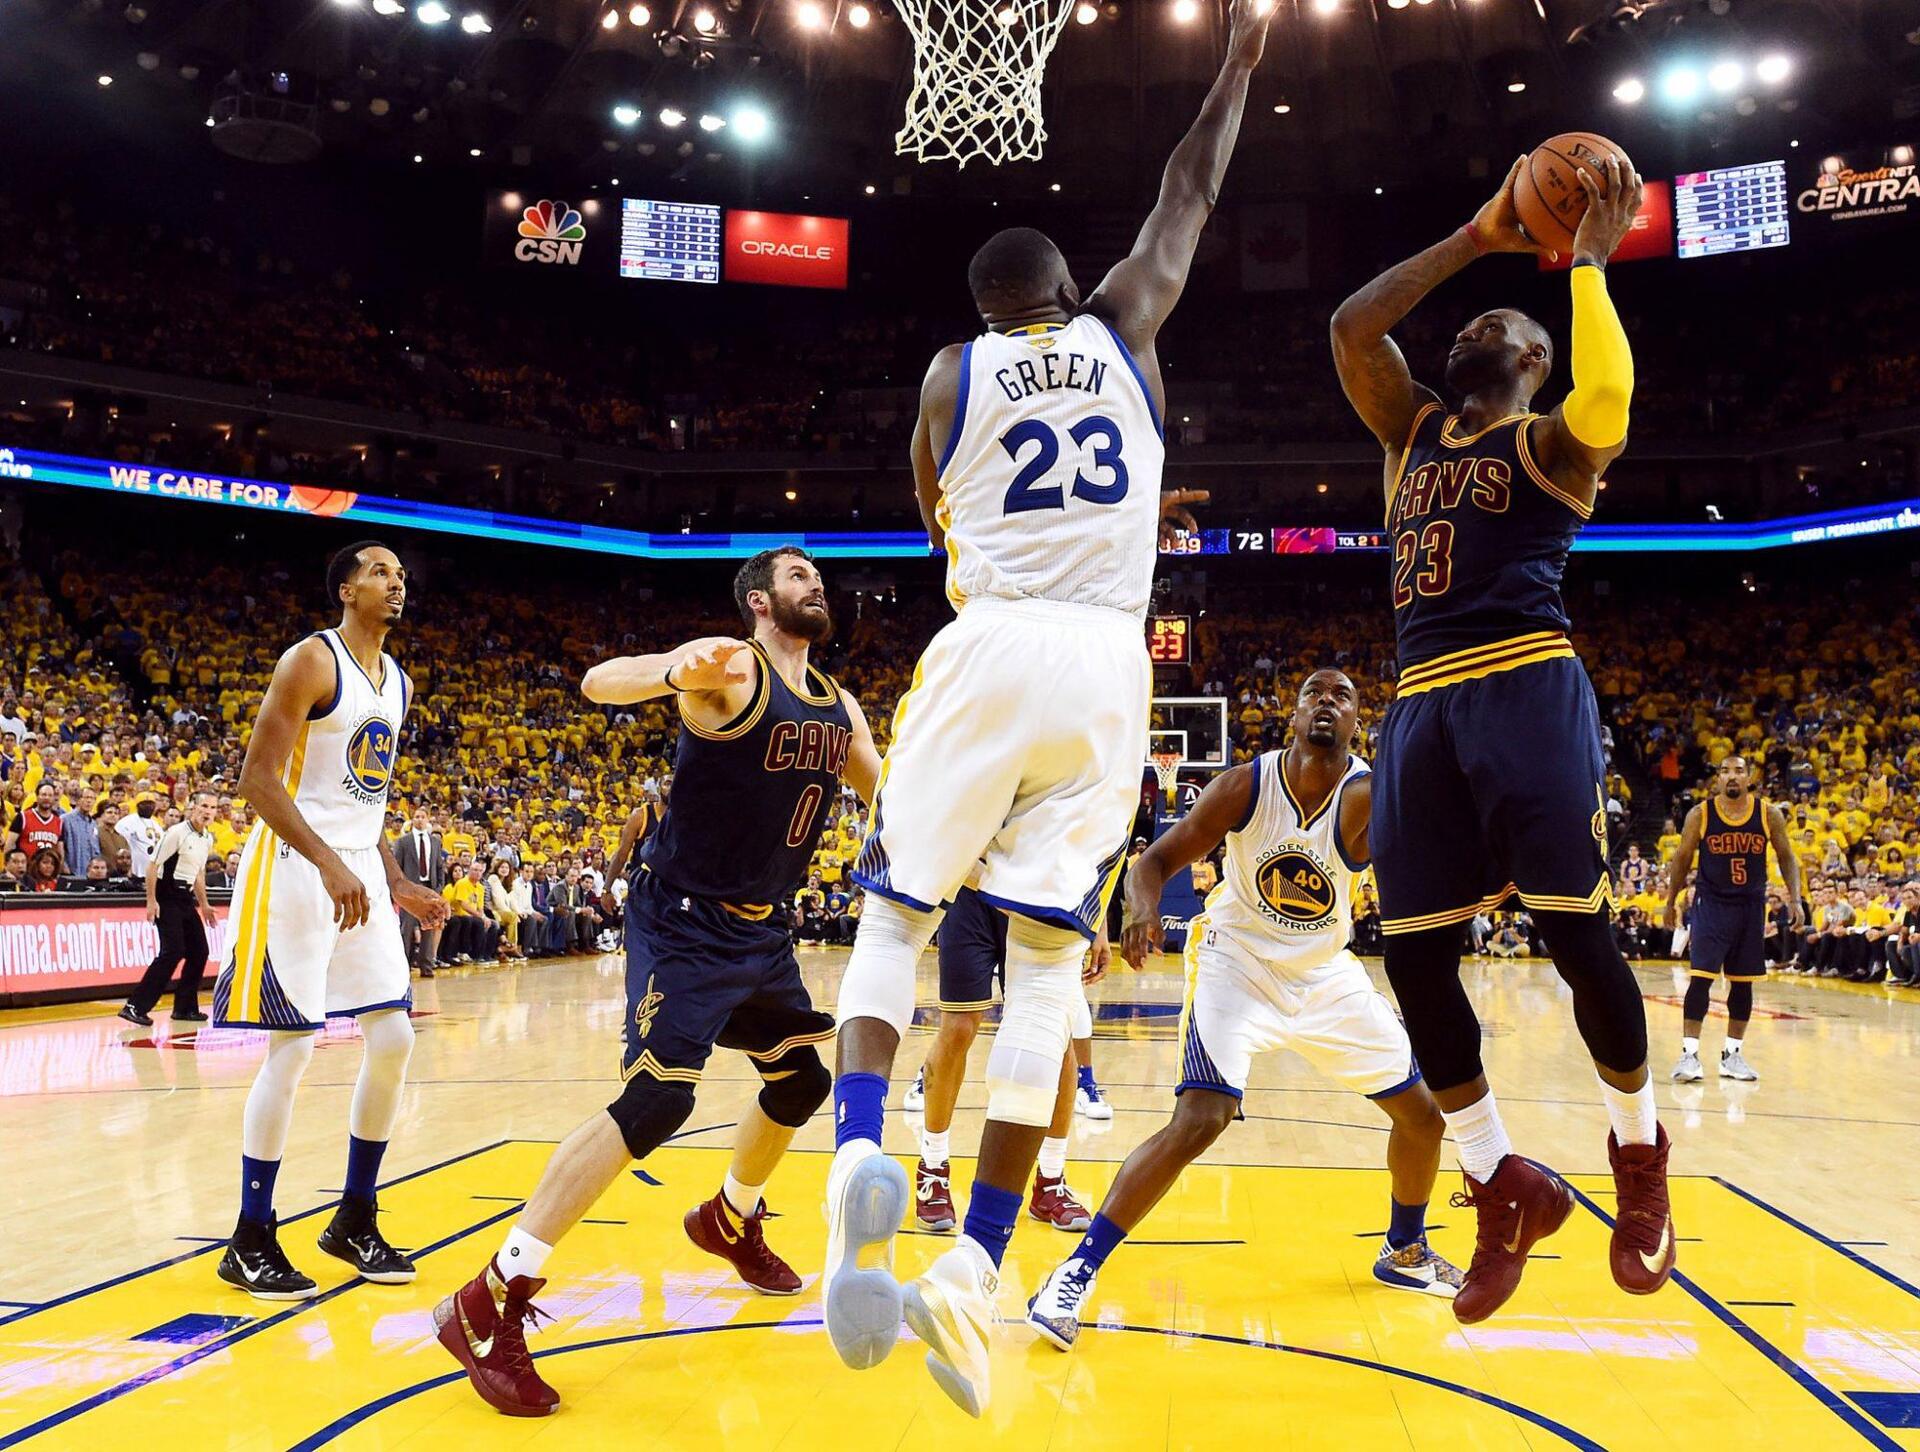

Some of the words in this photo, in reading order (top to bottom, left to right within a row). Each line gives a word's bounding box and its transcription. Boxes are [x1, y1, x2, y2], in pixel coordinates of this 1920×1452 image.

[514, 239, 583, 265] CSN
[741, 241, 831, 260] ORACLE
[995, 353, 1108, 402] GREEN
[998, 415, 1129, 518] 23
[109, 466, 150, 491] WE
[157, 473, 223, 500] CARE
[230, 482, 279, 507] FOR
[1393, 457, 1511, 537] CAVS
[1236, 533, 1264, 550] 72
[1338, 536, 1356, 547] TOL
[1358, 536, 1367, 546] 2
[1371, 536, 1379, 546] 1
[1394, 520, 1454, 610] 23
[1155, 620, 1186, 635] 8:48
[1151, 634, 1182, 659] 23
[375, 733, 391, 755] 34
[787, 784, 822, 847] 0
[1707, 832, 1766, 854] CAVS
[1256, 843, 1304, 864] GOLDEN
[1308, 849, 1338, 880] STATE
[1731, 858, 1747, 885] 5
[1293, 869, 1322, 891] 40
[1161, 915, 1190, 930] Fina
[1257, 900, 1338, 931] WARRIORS
